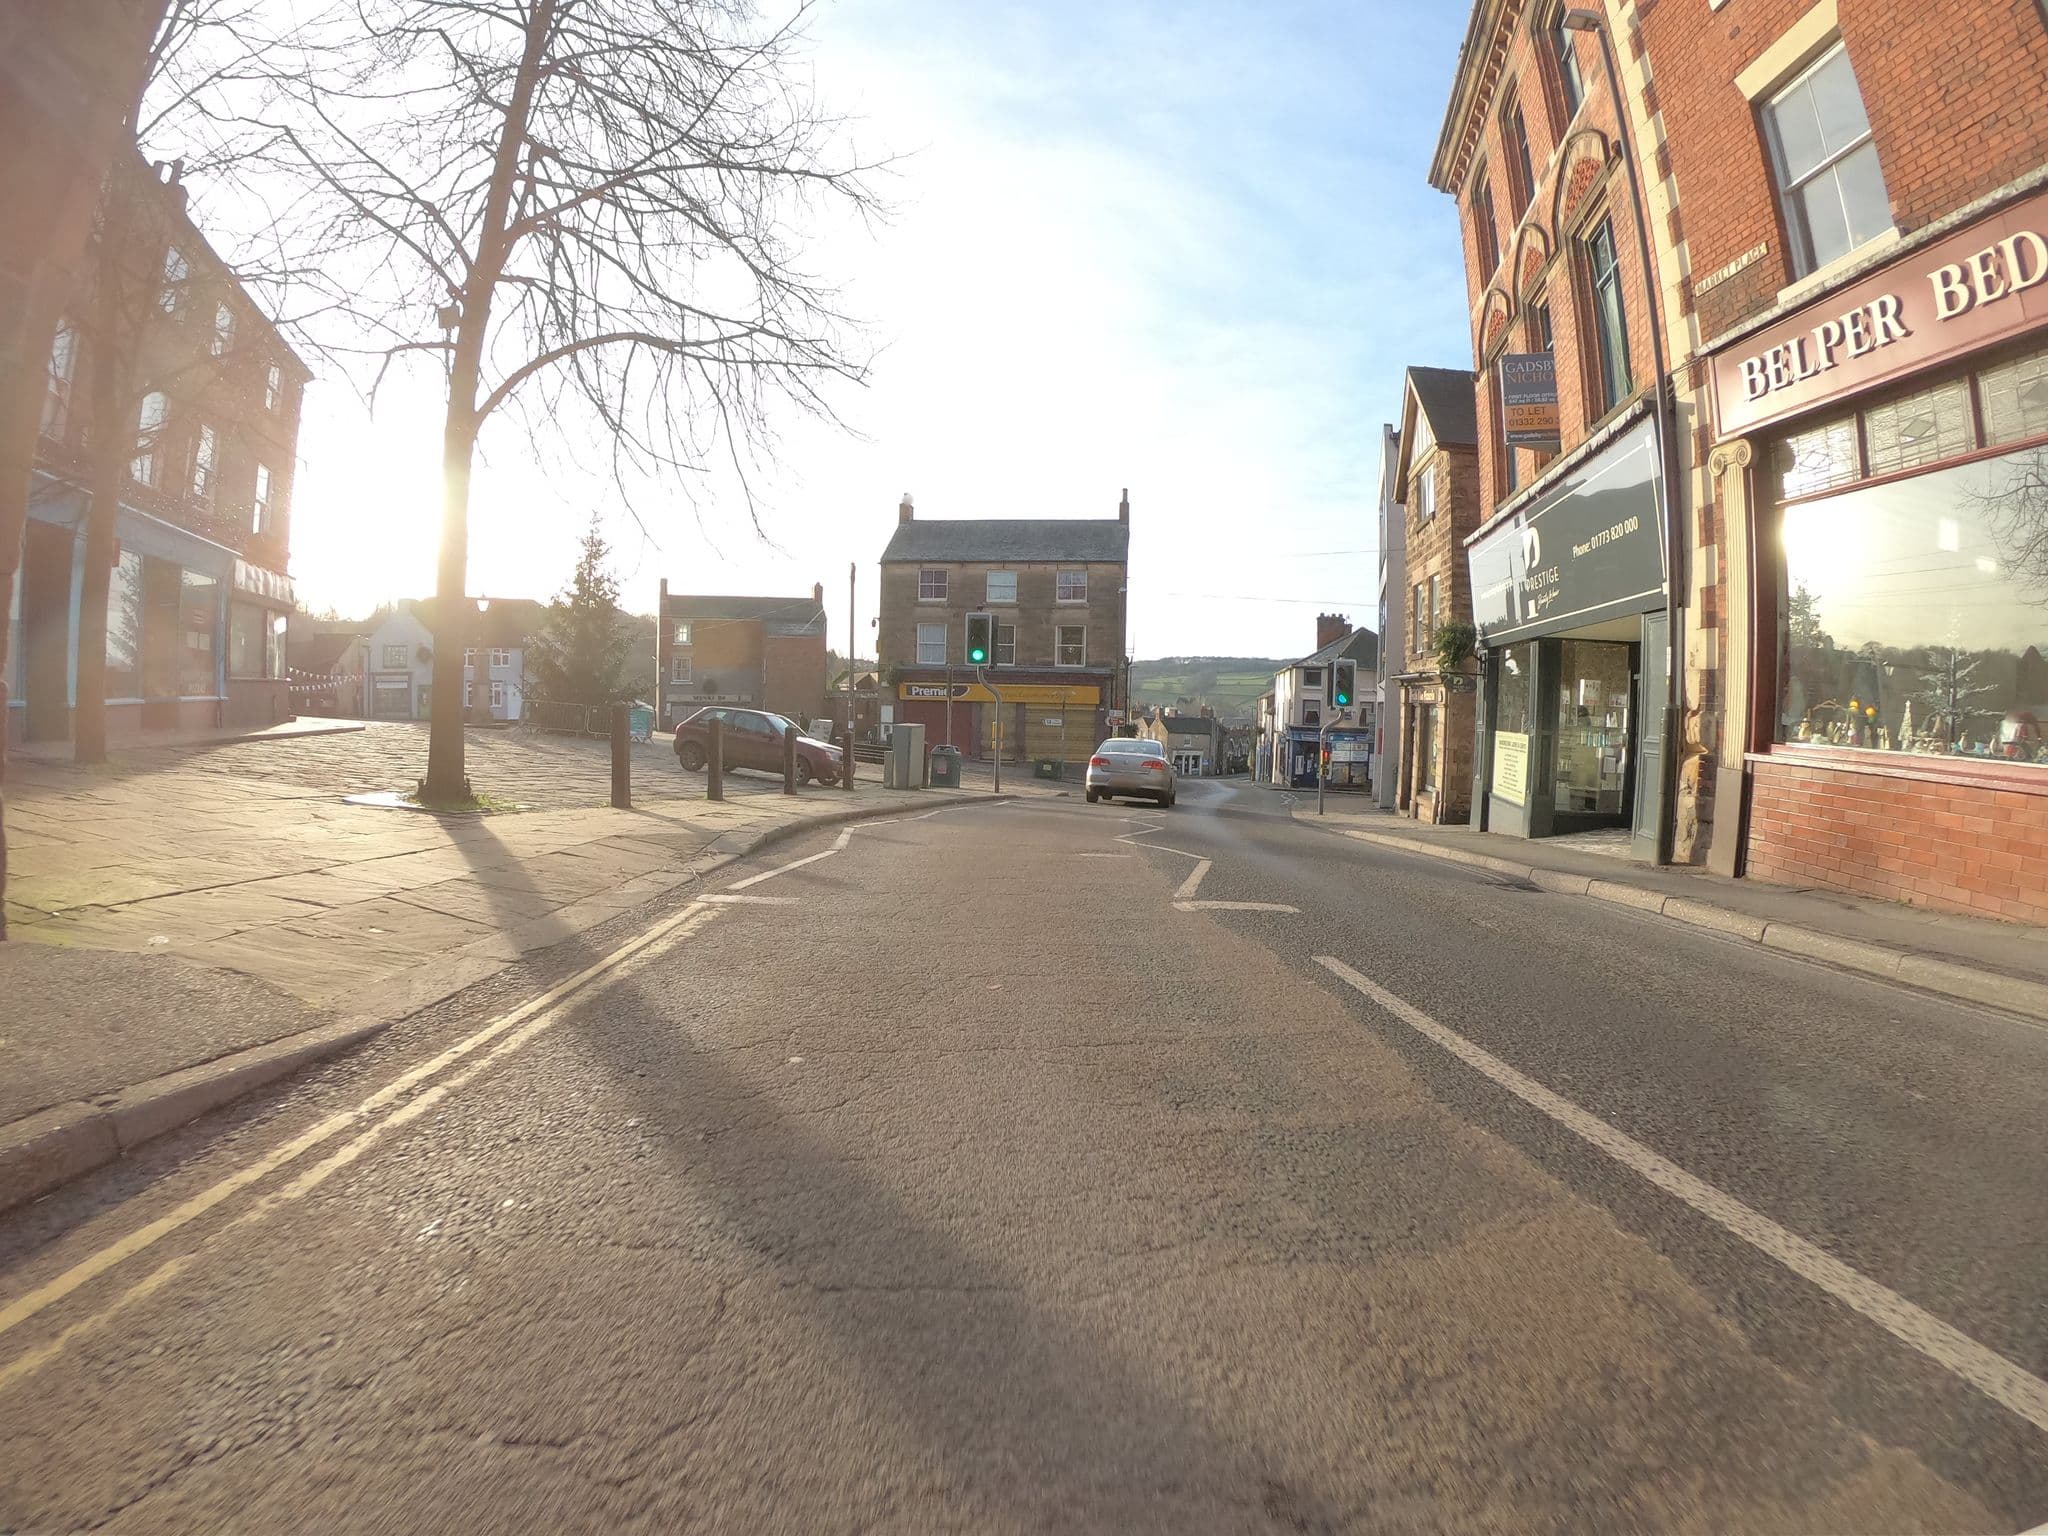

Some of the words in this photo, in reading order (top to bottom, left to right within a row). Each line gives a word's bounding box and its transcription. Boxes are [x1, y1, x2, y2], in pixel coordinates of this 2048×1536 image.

[1697, 264, 1731, 293] MARKET
[1735, 243, 1767, 272] PLACE
[1738, 294, 1907, 401] BELPER
[1509, 418, 1534, 427] 01332
[1537, 417, 1554, 425] 290
[1510, 407, 1525, 417] TO
[1528, 406, 1546, 415] LET
[1591, 529, 1610, 549] 01773
[1610, 523, 1624, 540] 820
[1624, 515, 1639, 534] 000
[1526, 566, 1560, 592] PRESTIGE
